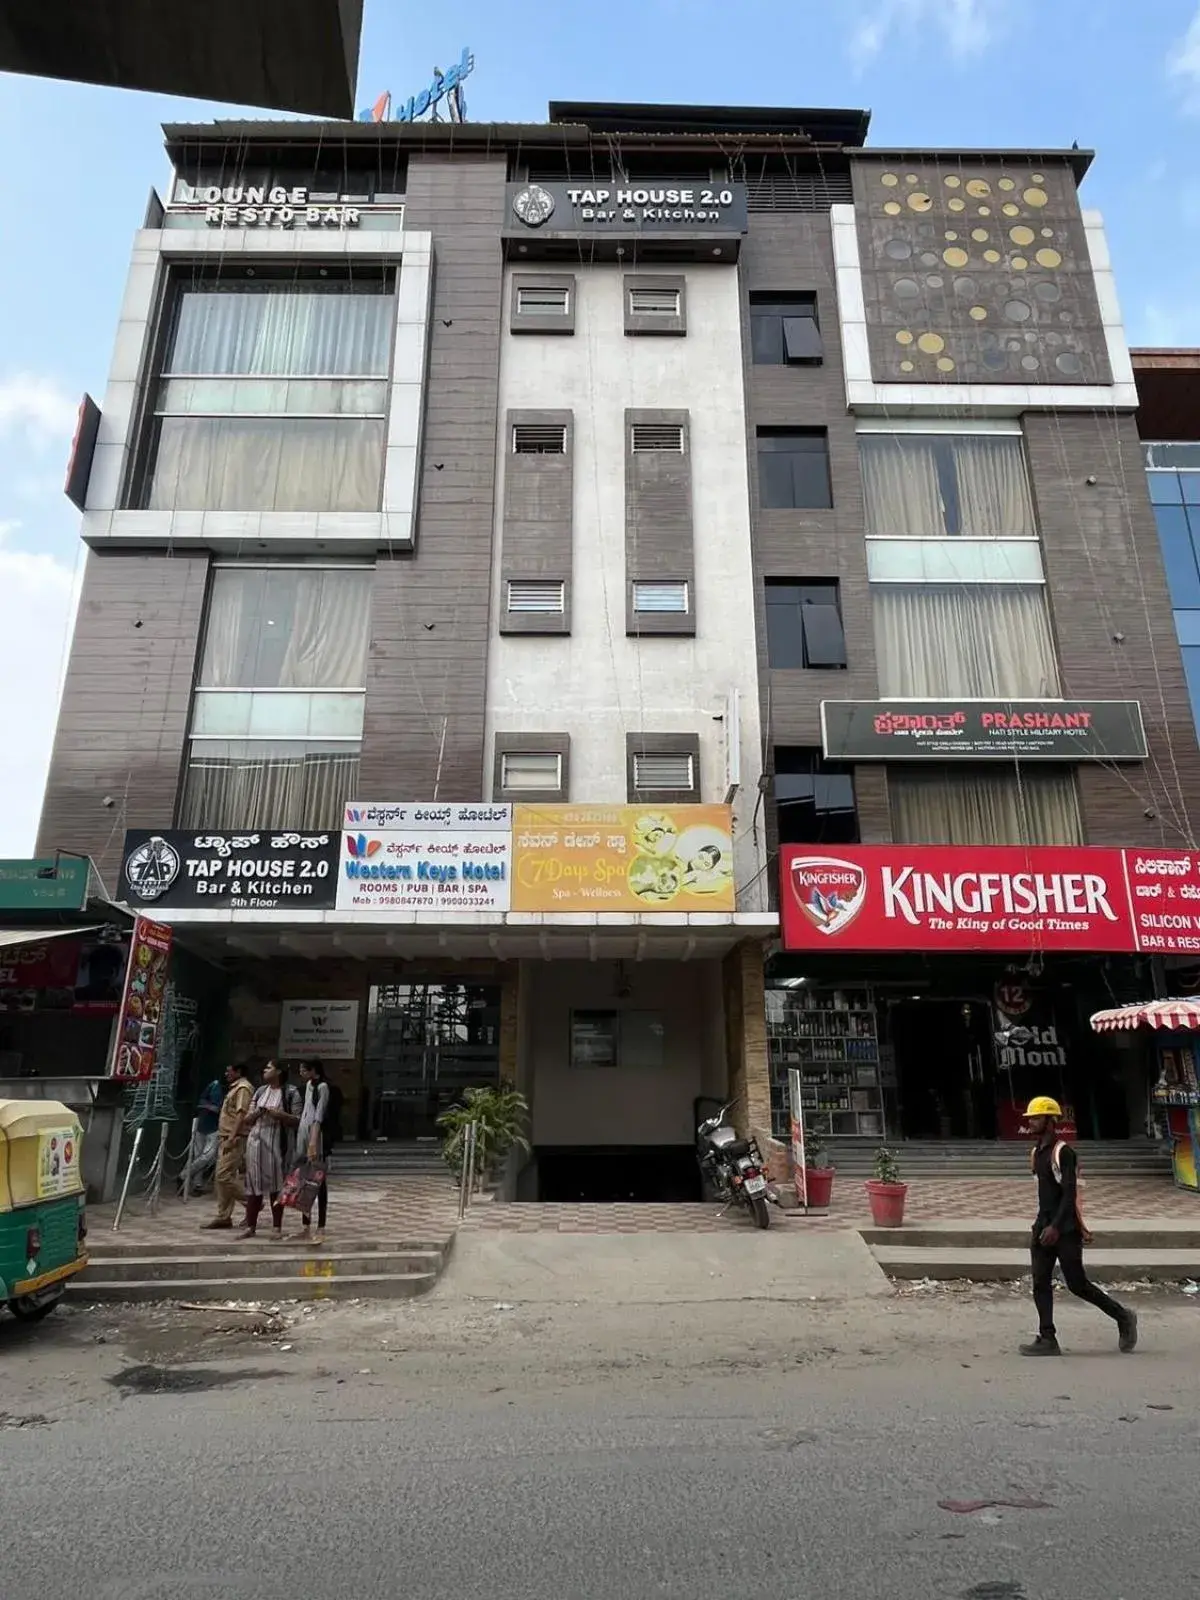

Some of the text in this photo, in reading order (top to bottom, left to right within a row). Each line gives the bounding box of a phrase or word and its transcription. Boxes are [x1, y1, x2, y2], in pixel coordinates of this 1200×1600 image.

[191, 186, 307, 204] LOUNGE
[567, 190, 733, 204] TAP HOUSE 2.0
[205, 207, 360, 223] RESTO BAR
[582, 208, 720, 219] Bar & Kitchen
[982, 712, 1092, 728] PRASHANT
[1007, 728, 1029, 736] STYLE
[1030, 728, 1062, 736] MILITARY
[1063, 728, 1088, 736] HOTEL
[458, 807, 508, 821] ಹೋಟೆಲ್
[194, 833, 329, 857] ಟ್ಯಾಪ್ ಹೌಸ್
[463, 842, 507, 854] ಹೋಟೆಲ್
[186, 860, 329, 878] TAP HOUSE 2.0
[345, 861, 506, 883] Western Keys Hotel
[799, 871, 858, 887] KINGFISHER
[196, 881, 313, 894] Bar & Kitchen
[360, 884, 398, 893] ROOMS
[406, 884, 428, 893] PUB
[438, 884, 459, 893] BAR
[468, 884, 488, 893] SPA
[552, 888, 571, 900] Spa
[581, 887, 622, 898] Wellness
[1167, 886, 1176, 897] &
[230, 897, 277, 908] 5th Floor
[352, 896, 371, 904] Mob
[881, 866, 1119, 925] KINGFISHER
[928, 917, 1090, 933] The King of Good Times
[1140, 913, 1191, 928] SILICON
[1140, 935, 1165, 947] BAR
[1167, 936, 1176, 948] &
